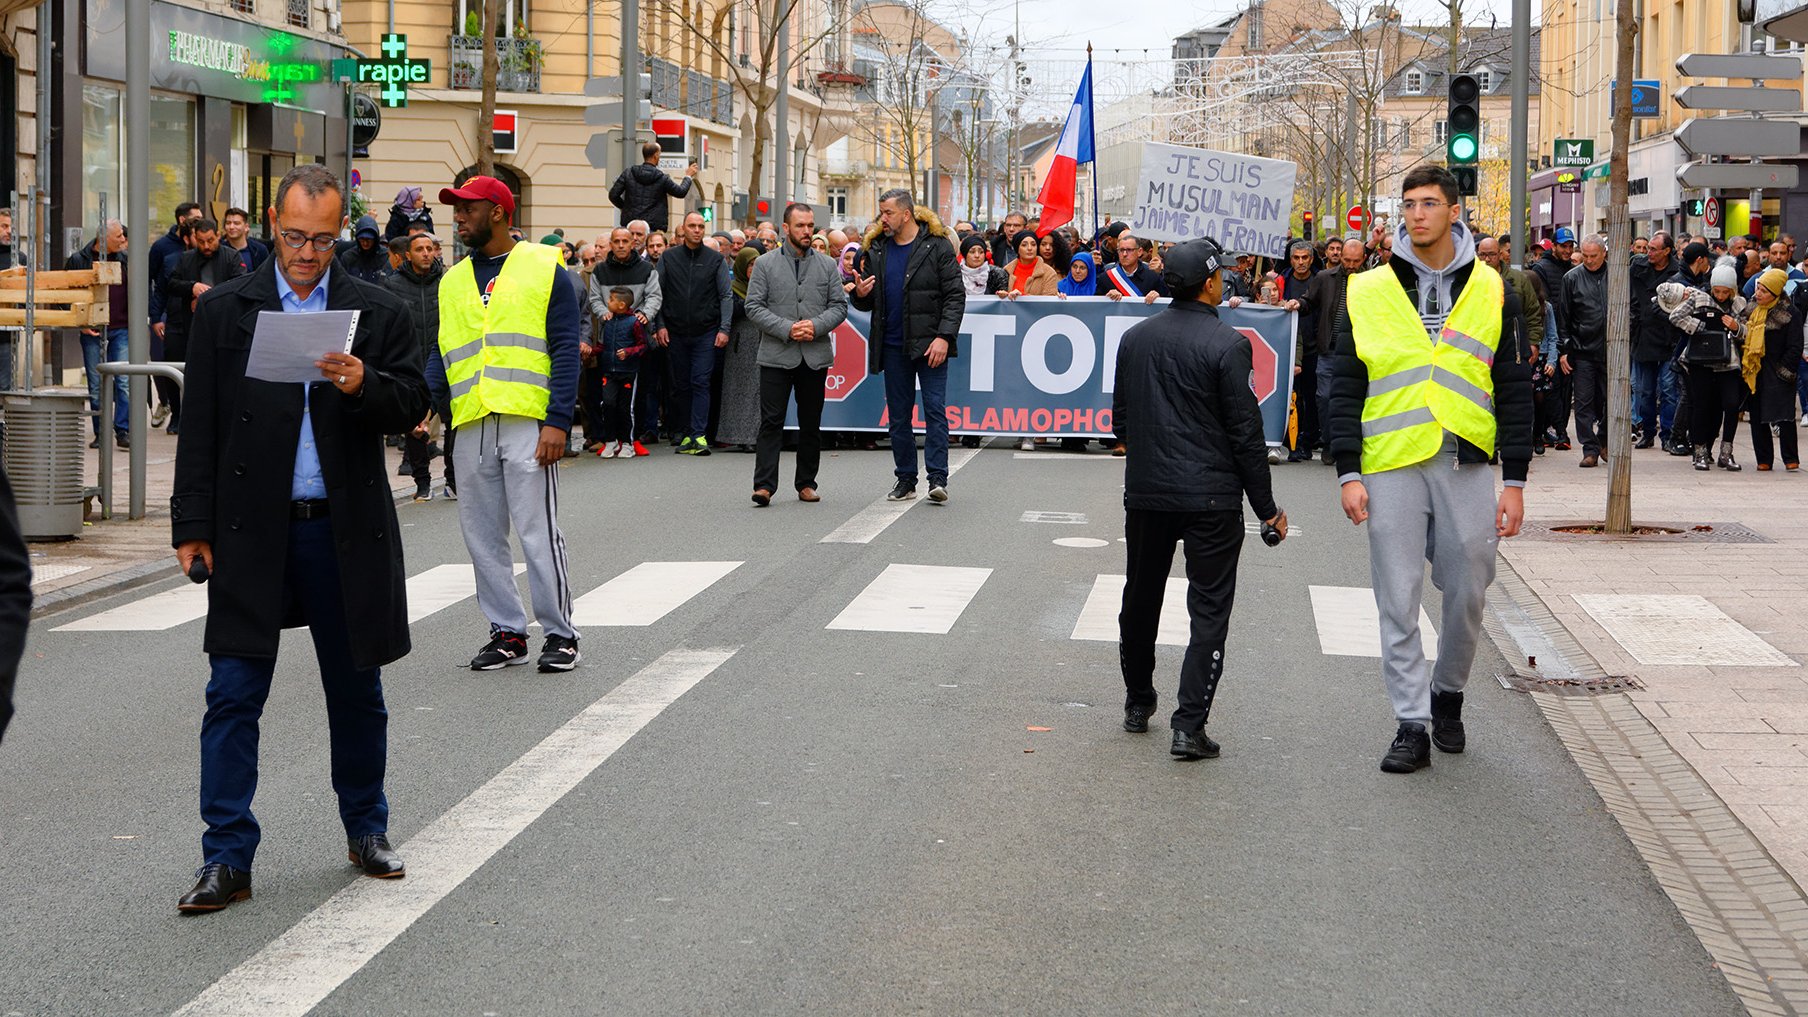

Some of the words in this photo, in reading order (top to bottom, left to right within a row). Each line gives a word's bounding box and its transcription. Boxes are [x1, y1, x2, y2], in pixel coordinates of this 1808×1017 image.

[175, 31, 248, 75] PHARMACIE
[359, 59, 426, 84] rapie
[353, 118, 377, 127] INNESS
[1166, 153, 1200, 180] JE
[1557, 157, 1591, 165] MEPHISTO
[1147, 180, 1281, 221] MUSULMAN
[1220, 218, 1287, 256] FRANCE
[911, 405, 1113, 433] LSLAMOPHO
